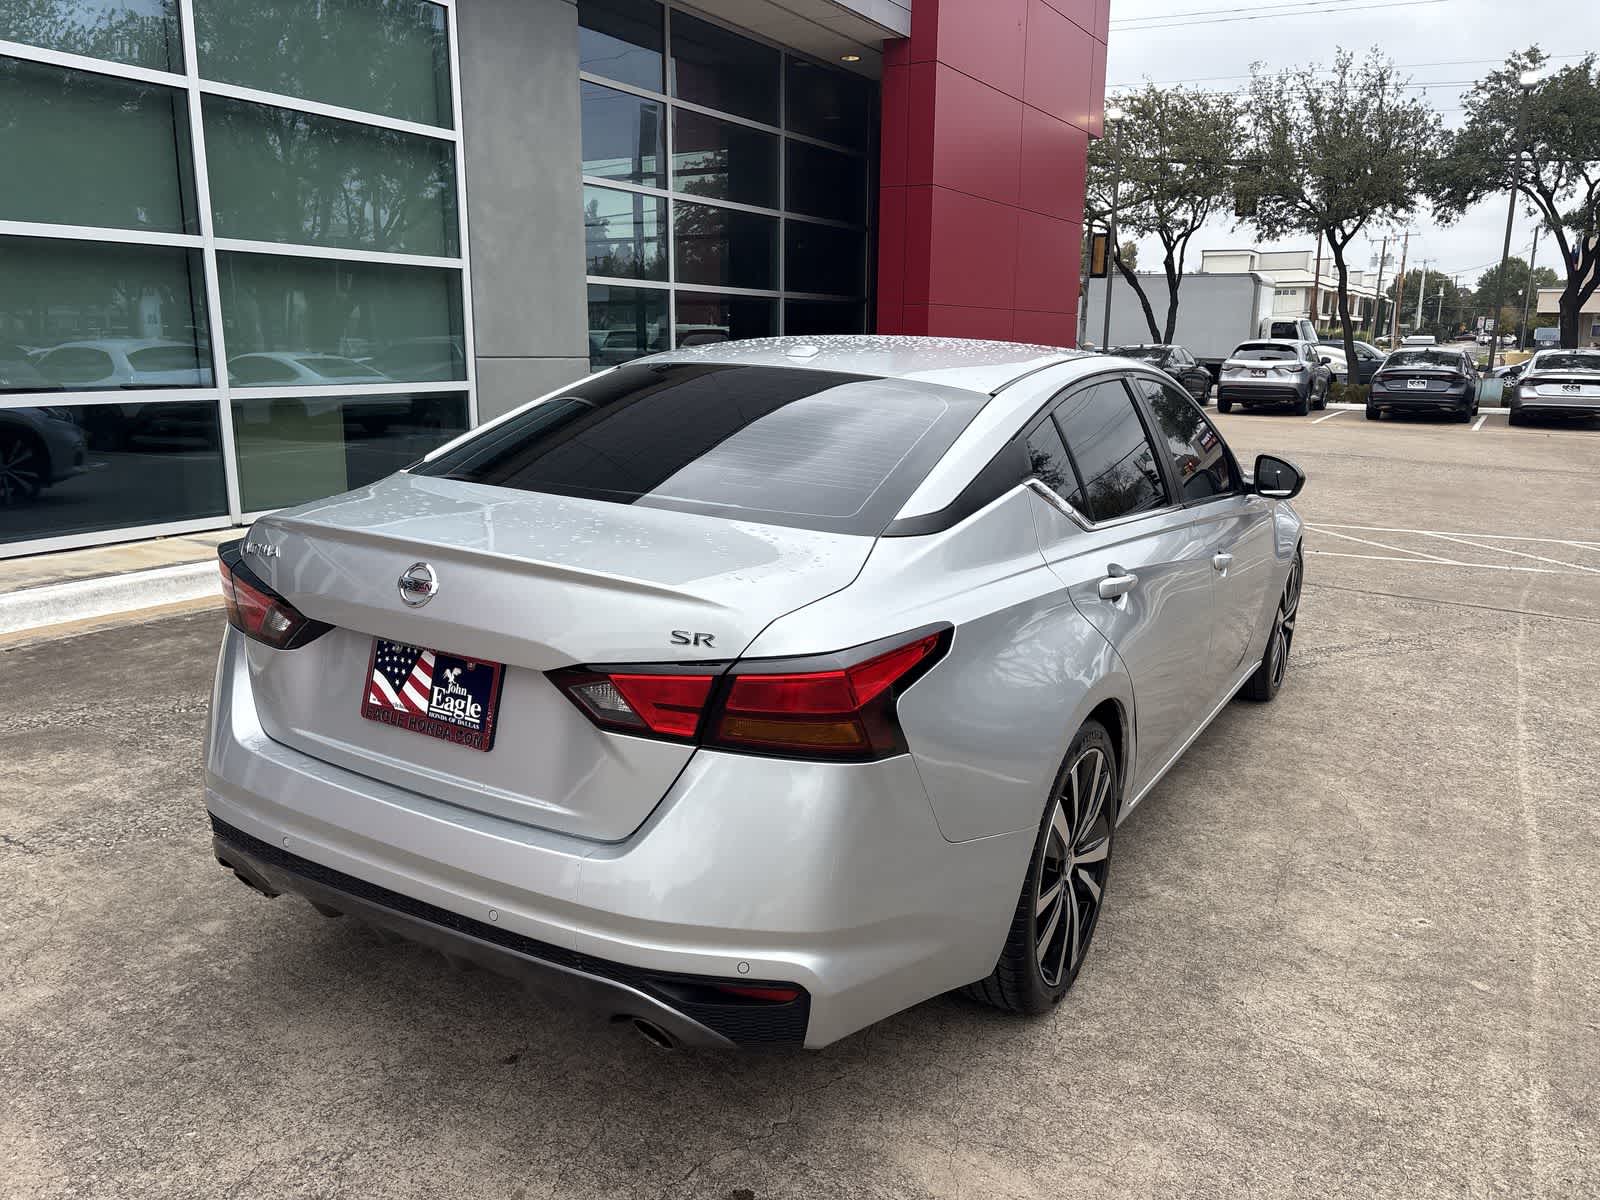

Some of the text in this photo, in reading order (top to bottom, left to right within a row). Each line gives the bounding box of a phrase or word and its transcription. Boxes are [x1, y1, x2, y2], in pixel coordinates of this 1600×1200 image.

[670, 629, 717, 649] SR
[445, 682, 467, 697] John
[430, 685, 482, 720] Eagle
[428, 711, 448, 722] HONDA
[457, 719, 480, 730] DALLAS
